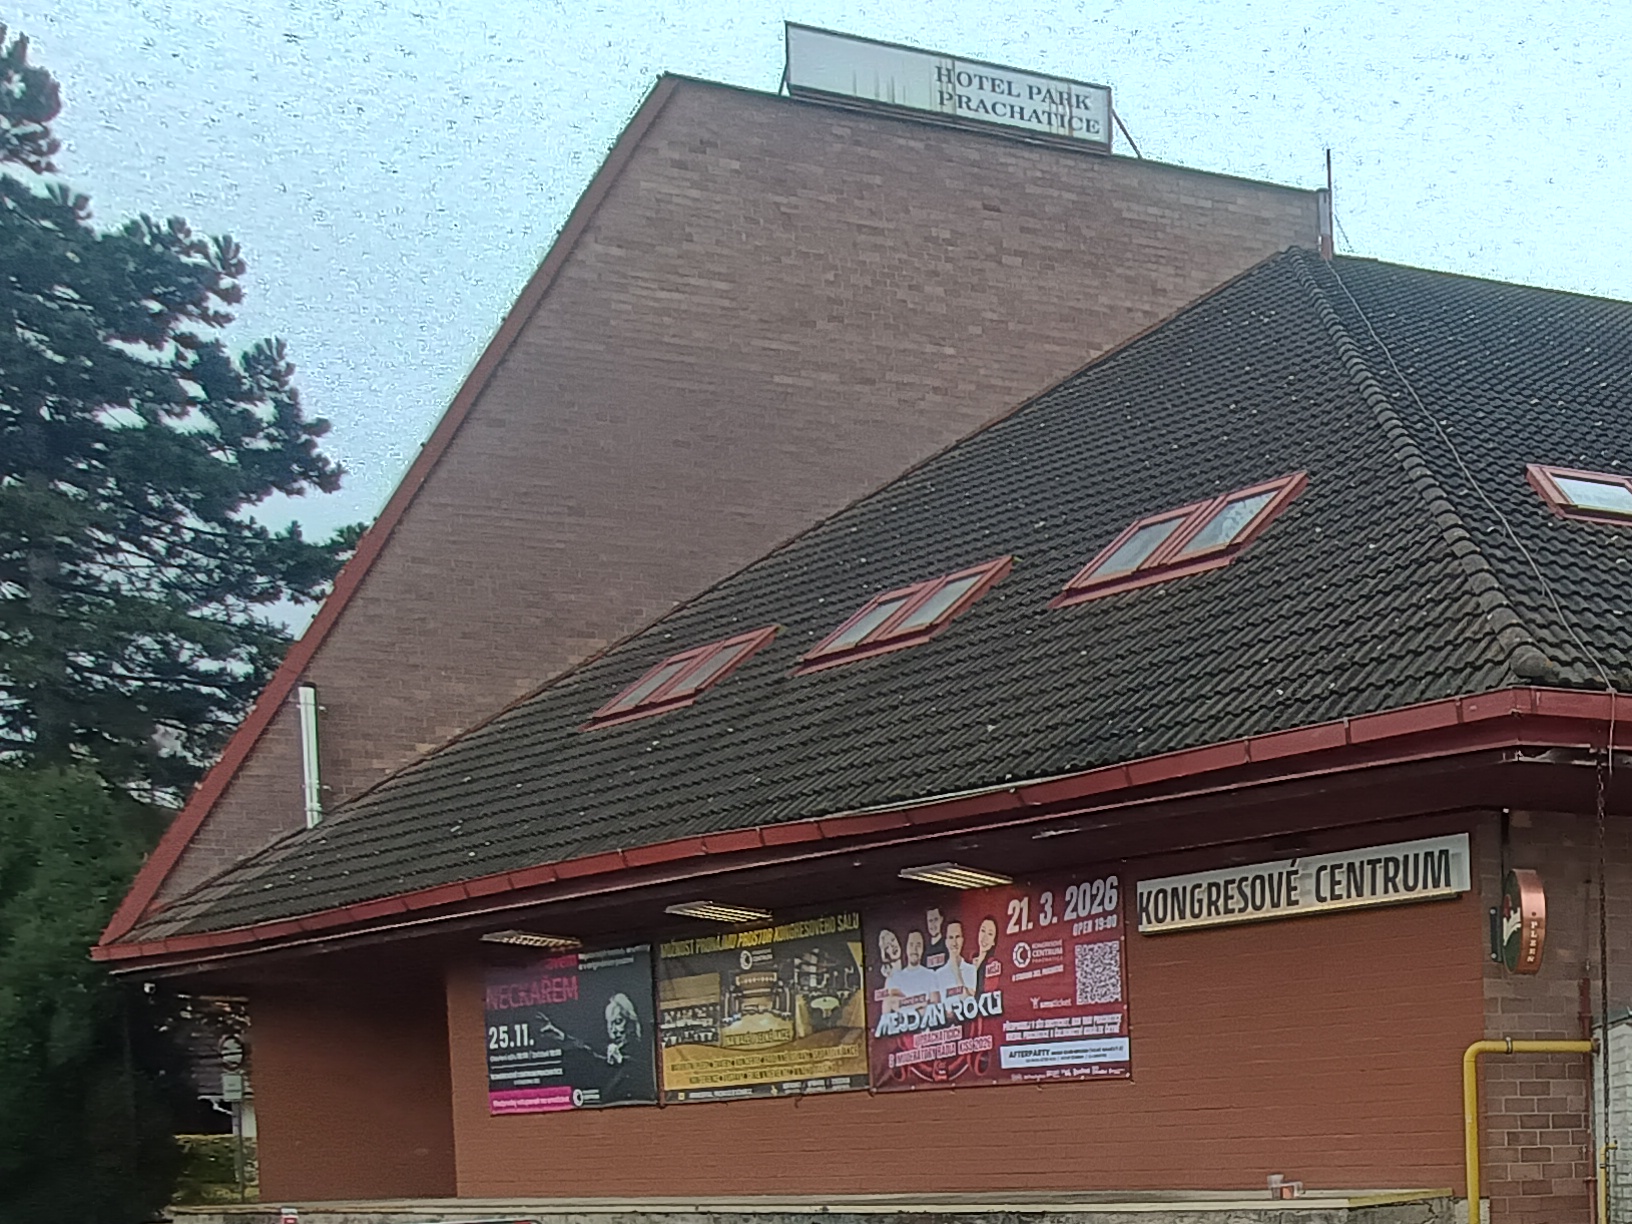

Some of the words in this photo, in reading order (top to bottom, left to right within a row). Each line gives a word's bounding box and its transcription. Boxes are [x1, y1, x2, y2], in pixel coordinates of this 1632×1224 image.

[935, 66, 1020, 98] HOTEL
[1027, 84, 1090, 110] PARK
[938, 90, 1100, 134] PRACHATICE
[1006, 897, 1033, 935] 21.
[1040, 891, 1058, 927] 3.
[1064, 876, 1118, 921] 2026
[1138, 858, 1299, 925] KONGRESOVÉ
[1315, 849, 1451, 903] CENTRUM
[489, 1023, 535, 1049] 25.11.
